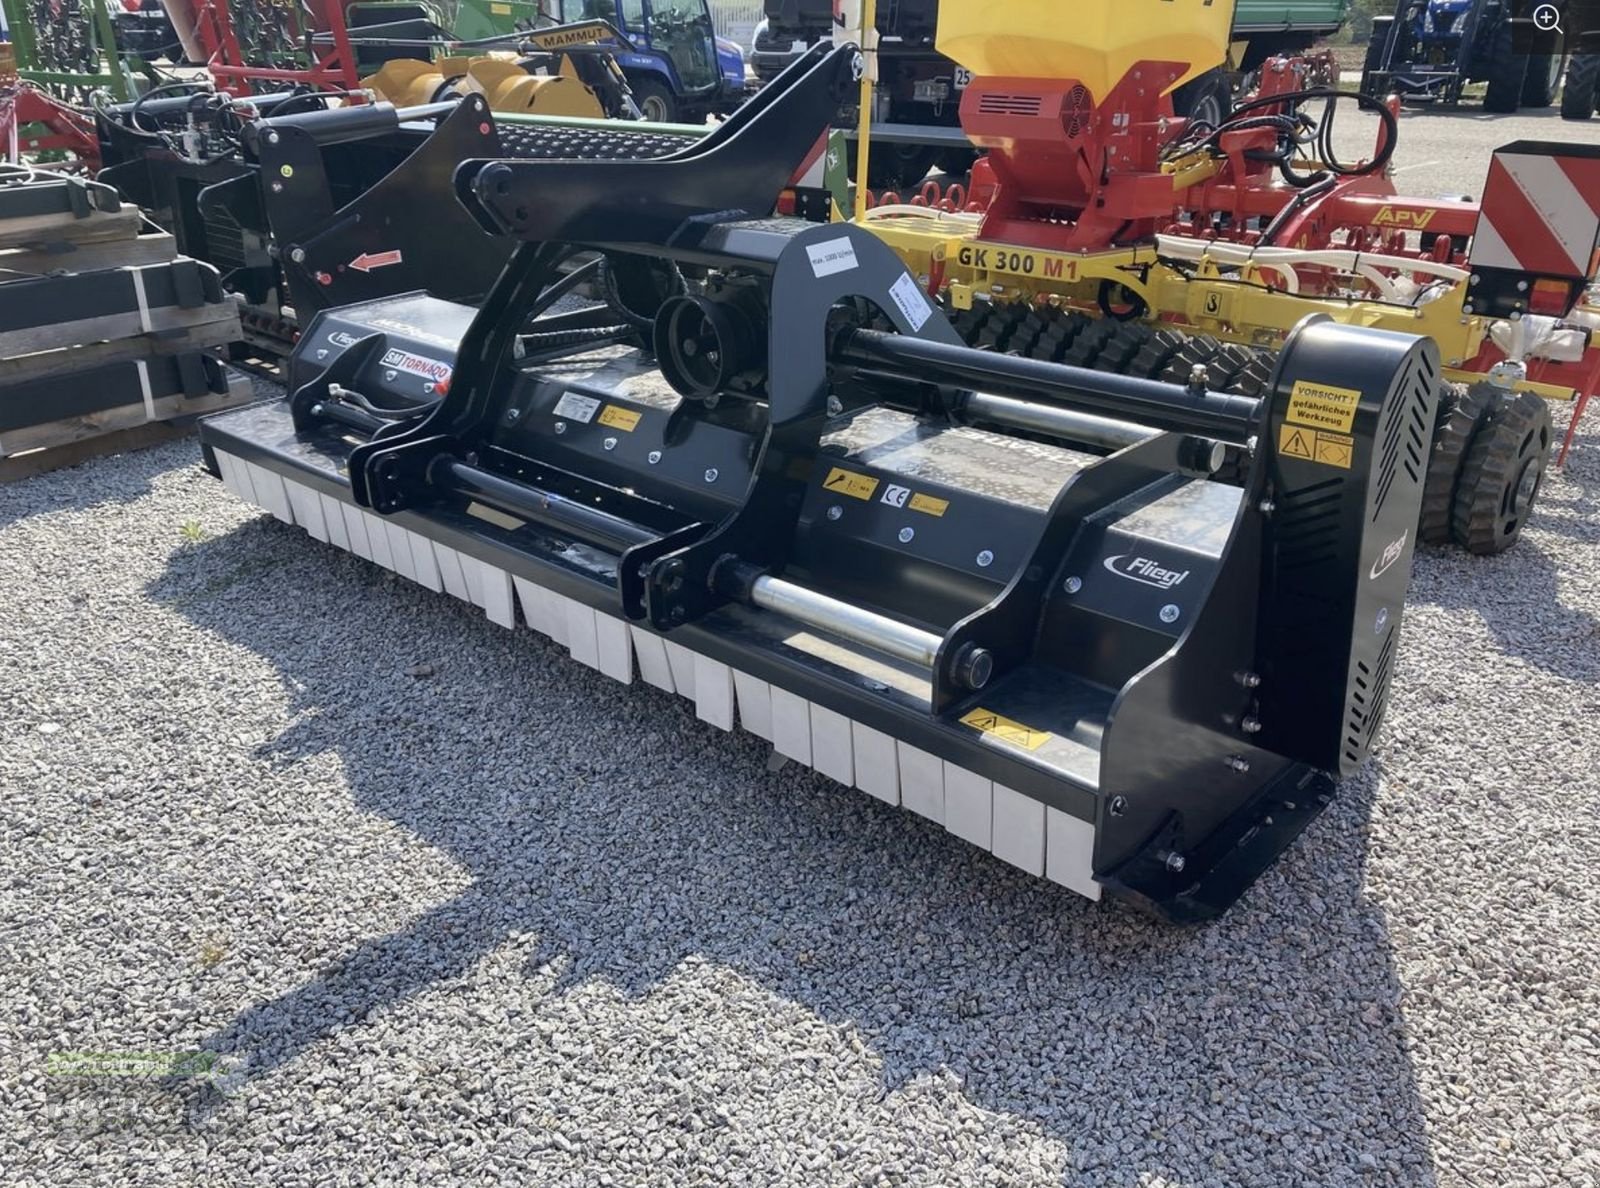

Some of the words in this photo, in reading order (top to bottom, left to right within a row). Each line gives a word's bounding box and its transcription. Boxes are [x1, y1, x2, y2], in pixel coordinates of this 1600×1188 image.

[544, 28, 603, 46] MAMMUT
[957, 69, 970, 85] 25
[1375, 208, 1433, 228] APV
[959, 247, 987, 268] GK
[995, 251, 1034, 274] 300
[1044, 257, 1077, 279] M1
[385, 351, 403, 367] SM
[401, 356, 448, 378] TORNADO
[1298, 386, 1348, 403] VORSICHT
[1293, 400, 1351, 417] gefährliches
[1297, 410, 1343, 426] Werkzeug
[886, 487, 908, 504] CE
[1122, 555, 1190, 587] Fliegl
